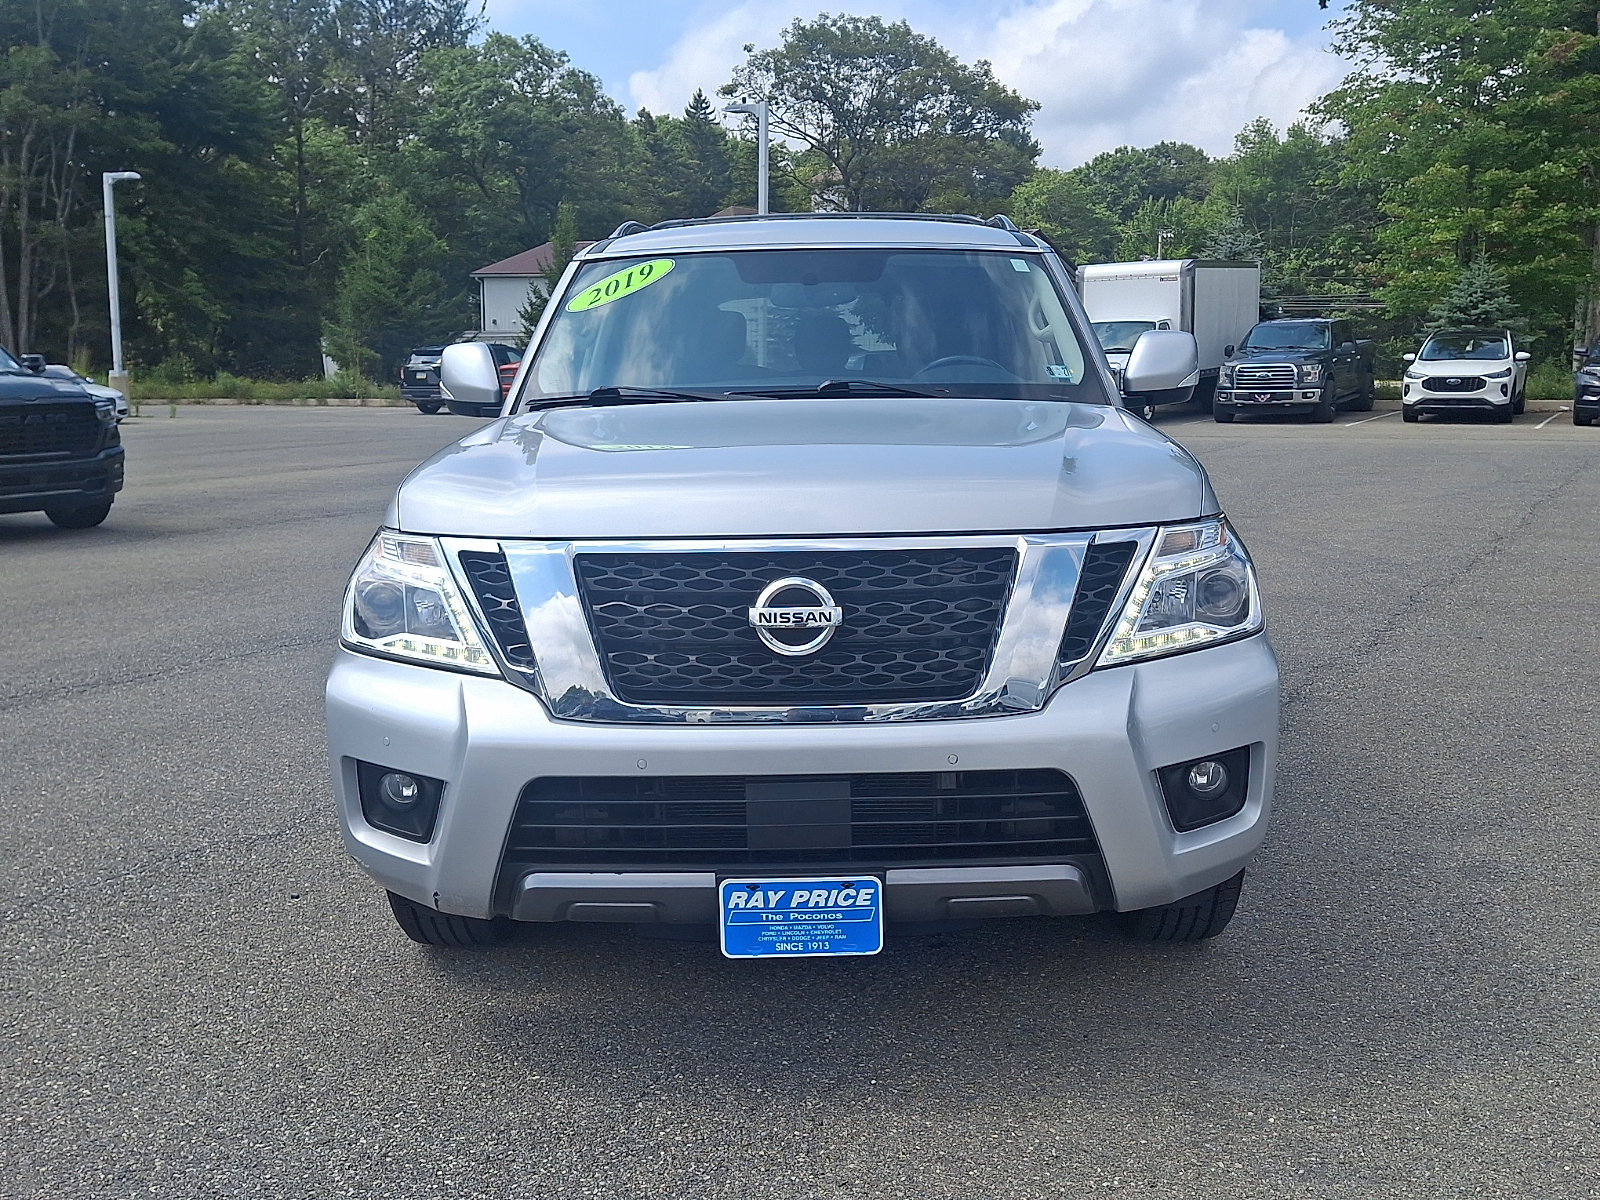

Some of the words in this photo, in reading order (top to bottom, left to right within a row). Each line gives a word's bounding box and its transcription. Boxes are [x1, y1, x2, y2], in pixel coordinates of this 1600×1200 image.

[588, 264, 654, 306] 2019
[758, 611, 832, 624] NISSAN
[728, 890, 787, 909] RAY
[790, 888, 875, 908] PRICE
[760, 913, 784, 921] The
[790, 912, 843, 921] Poconos
[775, 942, 804, 951] SINCE
[808, 941, 830, 950] 1913
